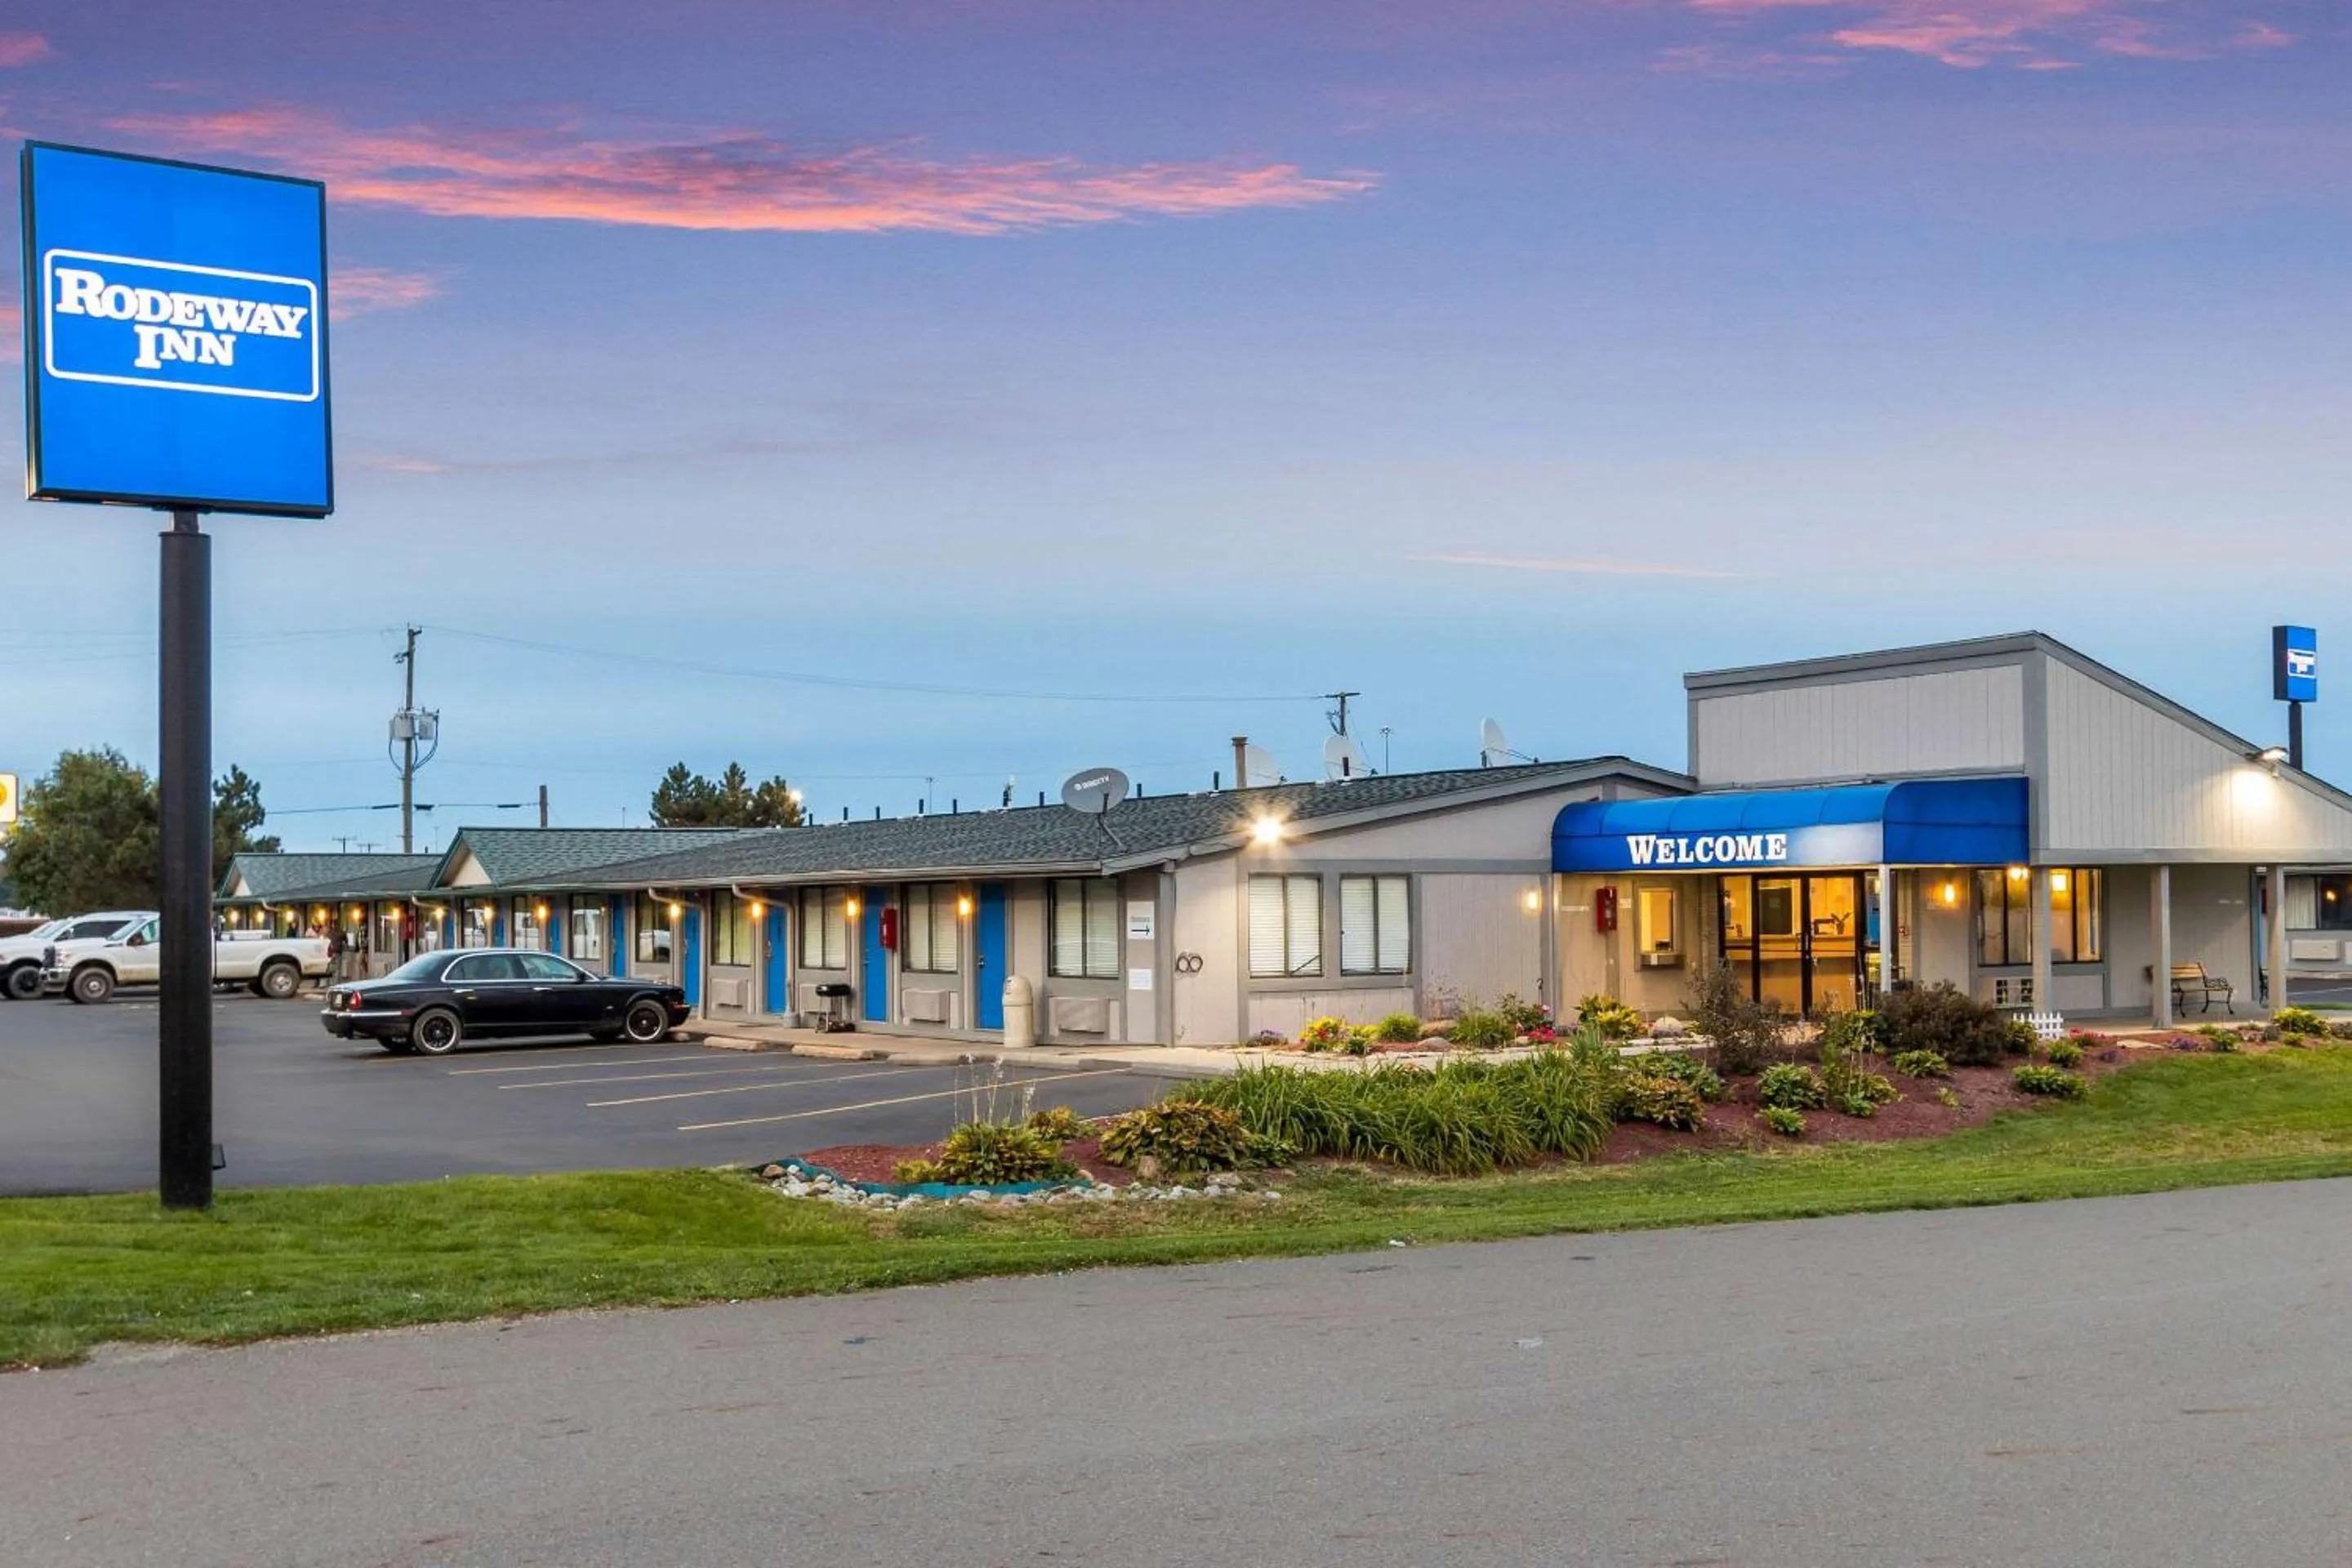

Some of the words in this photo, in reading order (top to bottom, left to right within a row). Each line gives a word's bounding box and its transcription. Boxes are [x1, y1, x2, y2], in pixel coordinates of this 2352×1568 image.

[55, 268, 308, 338] RODEWAY
[134, 325, 236, 369] INN
[1626, 834, 1787, 865] WELCOME
